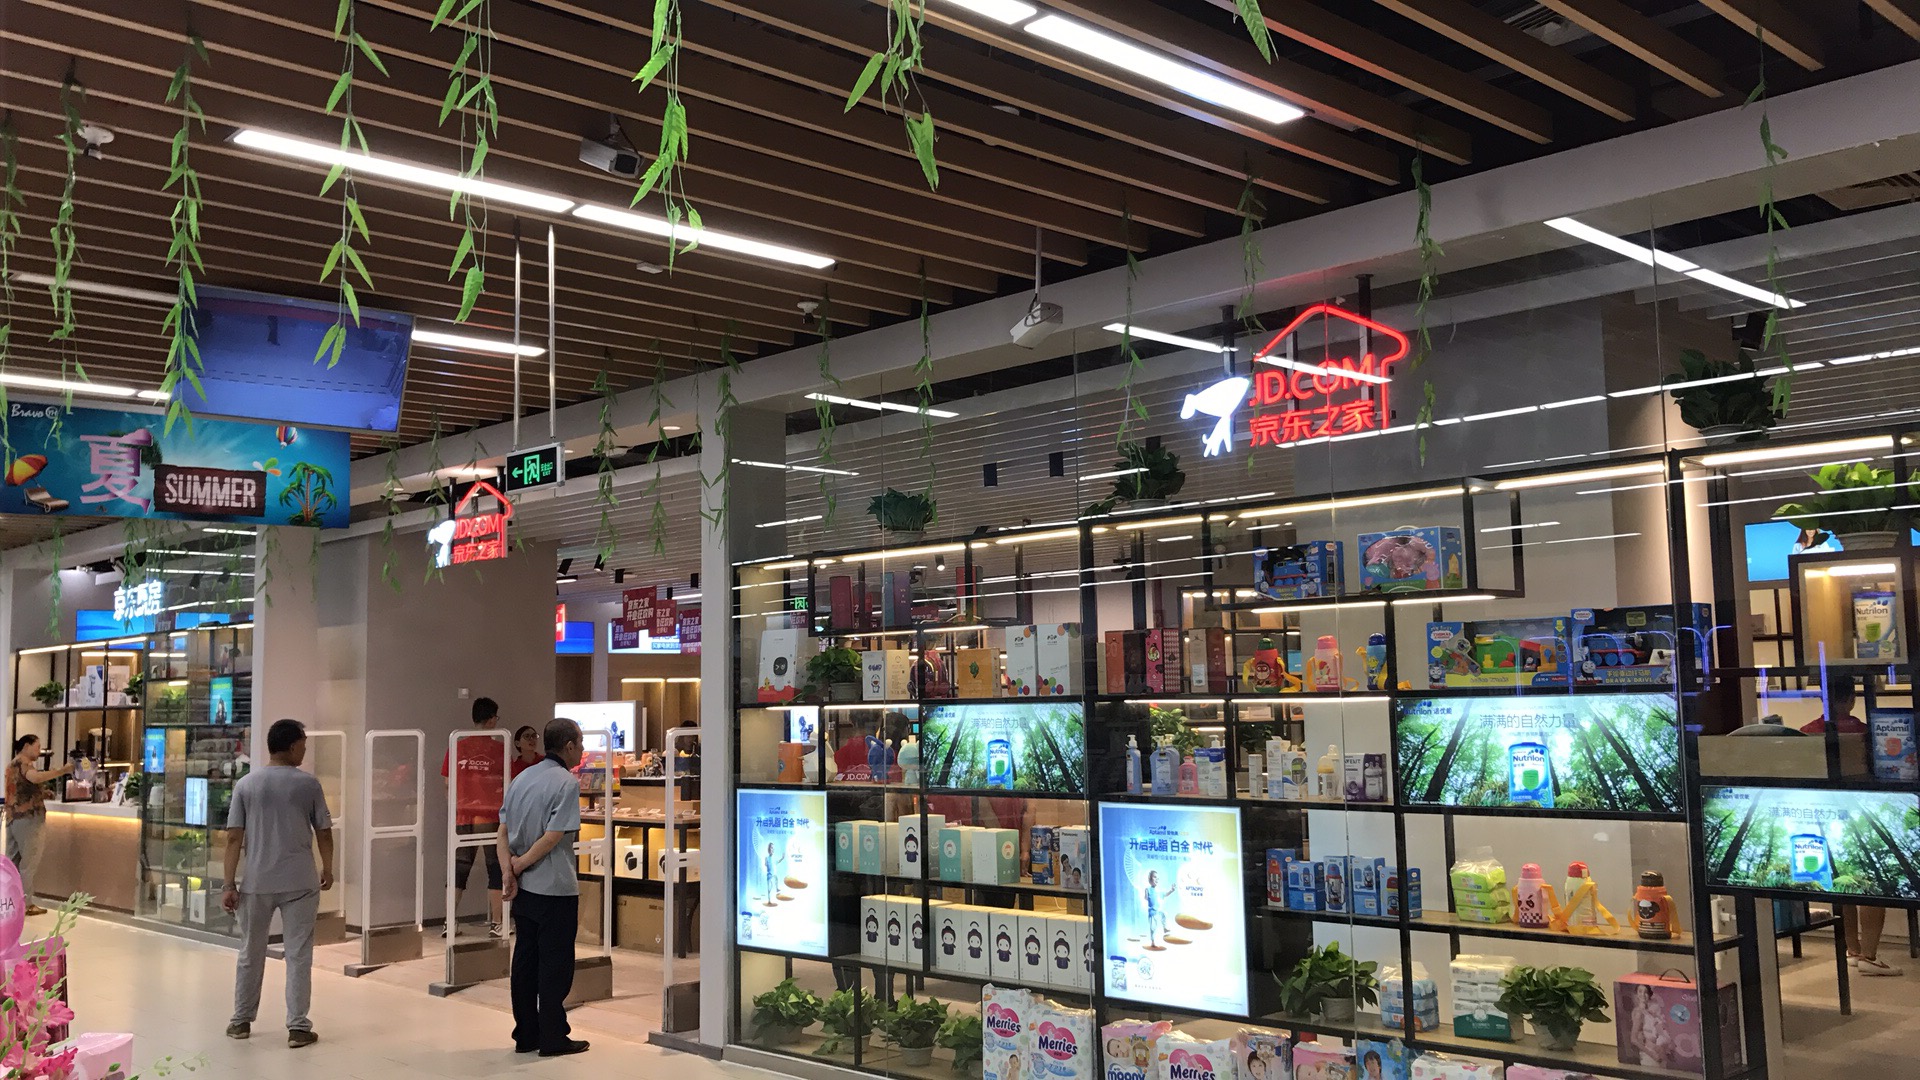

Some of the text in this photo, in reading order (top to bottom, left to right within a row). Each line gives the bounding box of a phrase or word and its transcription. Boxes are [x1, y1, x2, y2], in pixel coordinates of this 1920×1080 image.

[1249, 352, 1375, 406] JD.COM
[11, 403, 44, 418] Bravo
[1249, 400, 1376, 448] 京东之家
[79, 428, 154, 515] 夏
[164, 472, 257, 509] SUMMER
[1856, 606, 1889, 615] Nutrilon
[1479, 712, 1579, 730] 满满的自然力量
[1875, 724, 1910, 733] Aptamil
[1513, 754, 1546, 763] Nutrilon
[1767, 806, 1850, 821] 满满的自然力量
[782, 817, 796, 829] 白金
[1129, 837, 1214, 856] 开启乳脂 白金 时代
[1794, 843, 1824, 851] Nutrilon
[986, 1015, 1021, 1034] Merries
[1038, 1035, 1078, 1056] Merries
